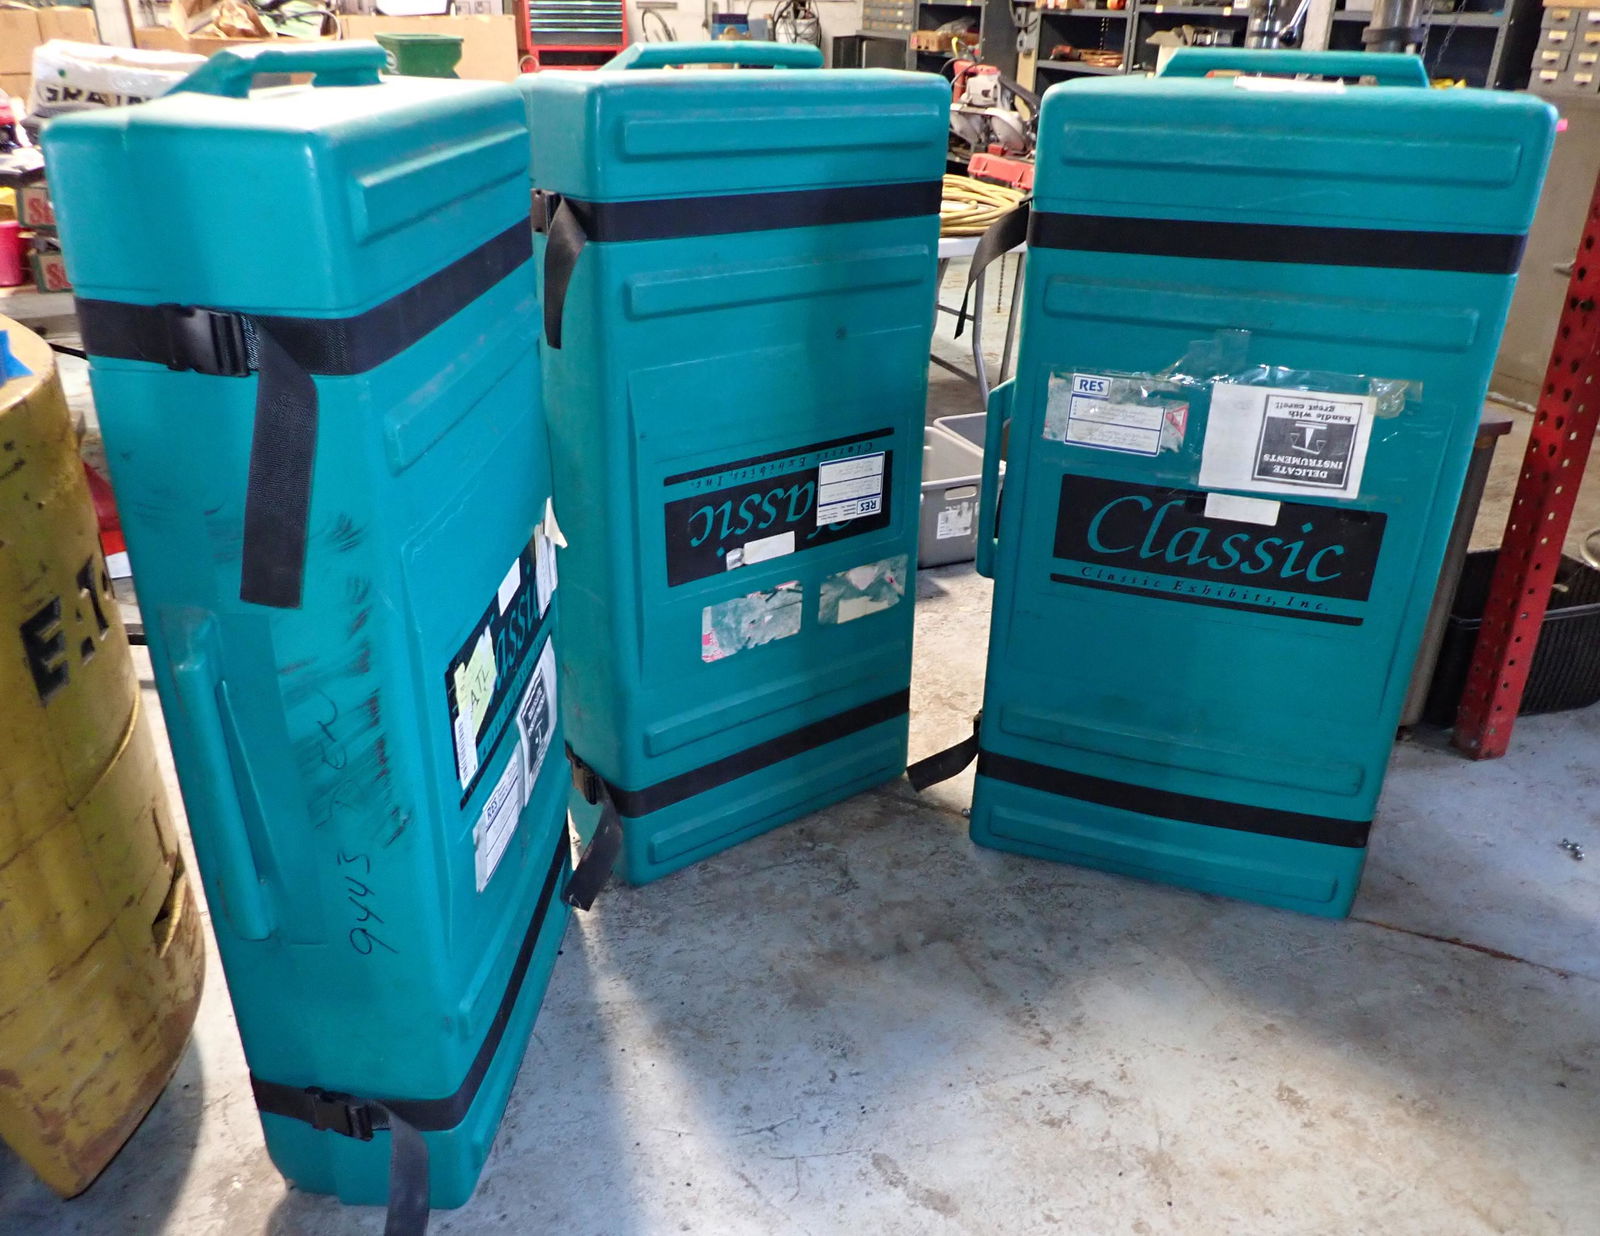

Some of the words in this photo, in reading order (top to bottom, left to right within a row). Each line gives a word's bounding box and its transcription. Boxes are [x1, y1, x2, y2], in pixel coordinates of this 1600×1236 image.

[1079, 378, 1105, 393] RES
[1288, 410, 1312, 418] with
[1316, 412, 1352, 423] handle
[1263, 453, 1344, 470] INSTRUMENTS
[1273, 464, 1328, 479] DELICATE
[860, 499, 877, 512] RES
[689, 479, 852, 557] assic
[1087, 493, 1347, 583] Classic
[1081, 566, 1161, 589] Classic
[1172, 579, 1277, 608] Exhibits,
[1286, 596, 1331, 612] Inc.
